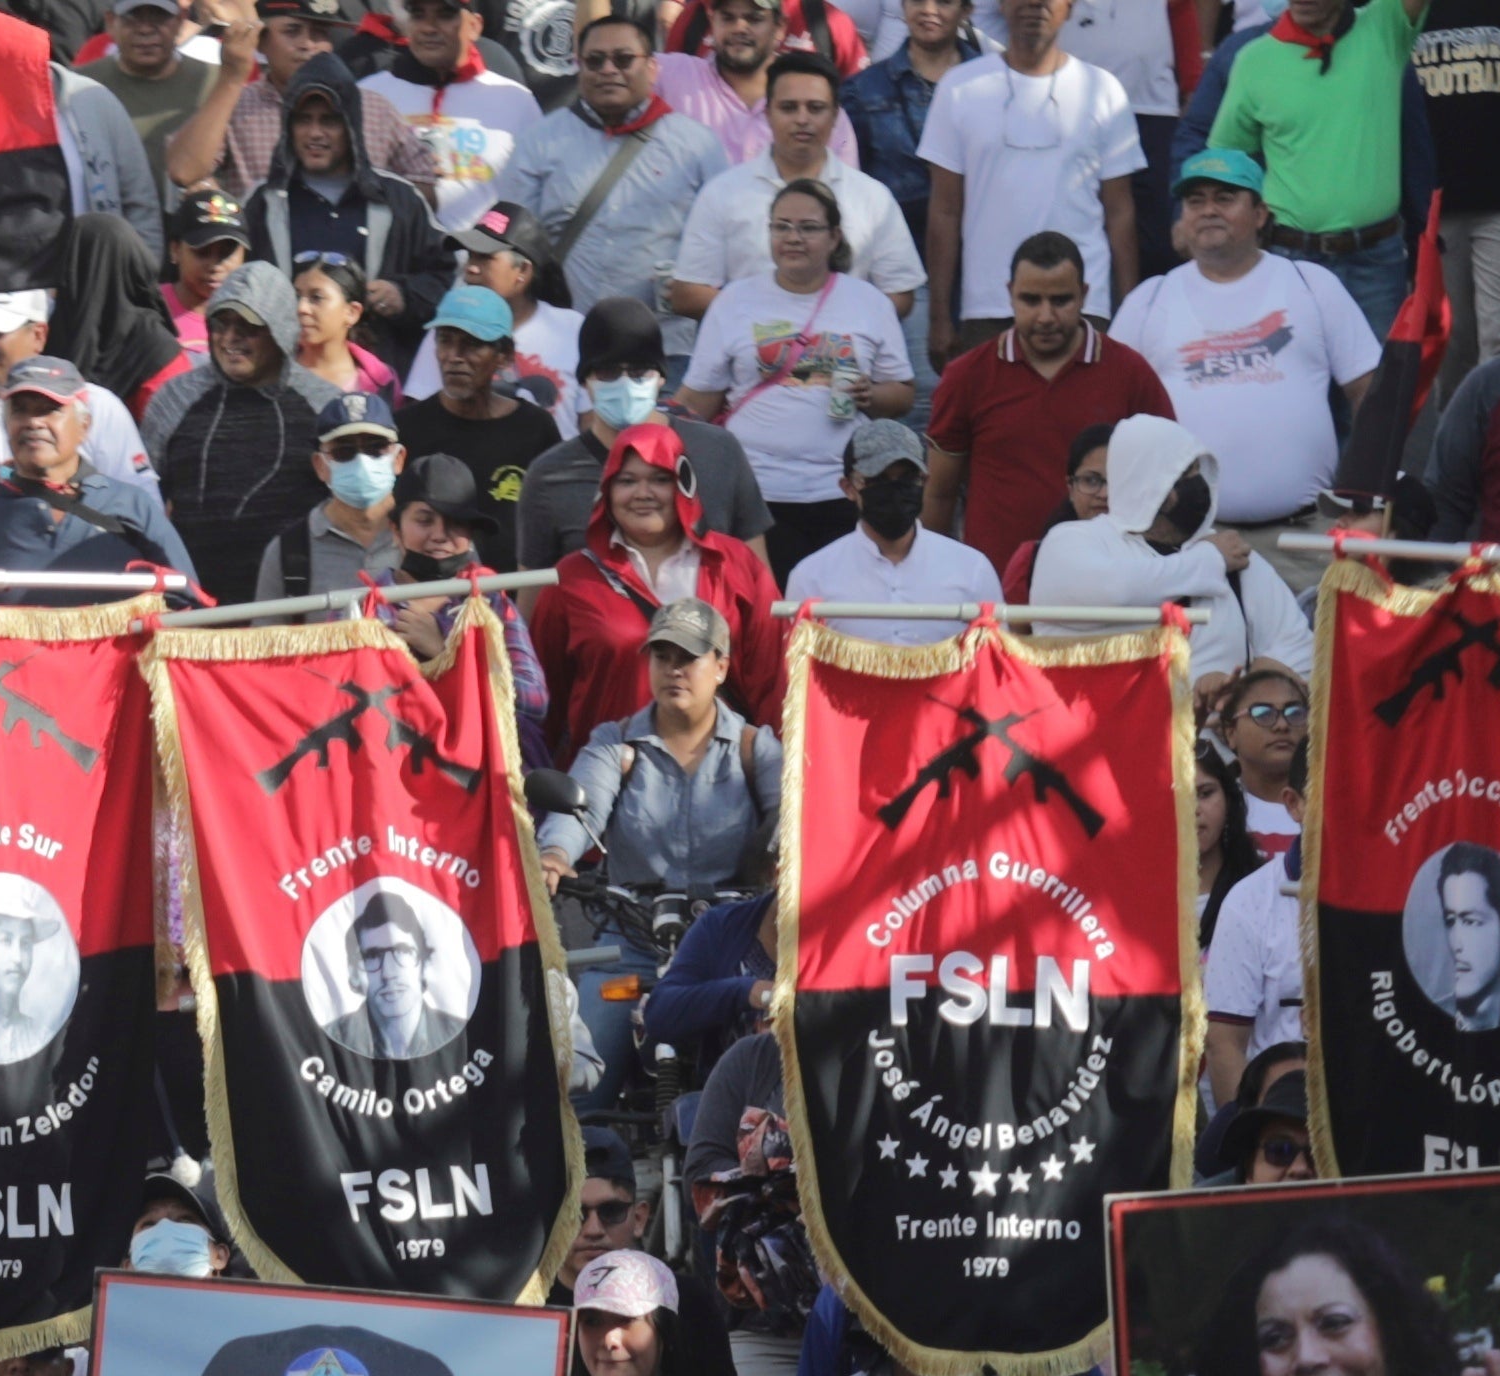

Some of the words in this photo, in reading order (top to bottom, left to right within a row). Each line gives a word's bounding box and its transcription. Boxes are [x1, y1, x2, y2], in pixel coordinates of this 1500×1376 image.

[1203, 351, 1275, 375] FSLN
[15, 820, 64, 862] Sur
[1383, 775, 1455, 847] Frente
[277, 833, 375, 902] Frente
[385, 825, 483, 891] Interno
[865, 857, 980, 949] Columna
[988, 850, 1117, 961] Guerrillera
[889, 950, 1091, 1033] FSLN
[298, 1055, 395, 1120] Camilo
[401, 1044, 496, 1116] Ortega
[867, 1028, 922, 1102] José
[908, 1093, 993, 1151] Ángel
[996, 1034, 1115, 1152] Benavidez
[339, 1163, 495, 1224] FSLN
[395, 1237, 447, 1260] 1979
[895, 1212, 979, 1243] Frente
[985, 1212, 1083, 1242] Interno
[961, 1256, 1011, 1279] 1979
